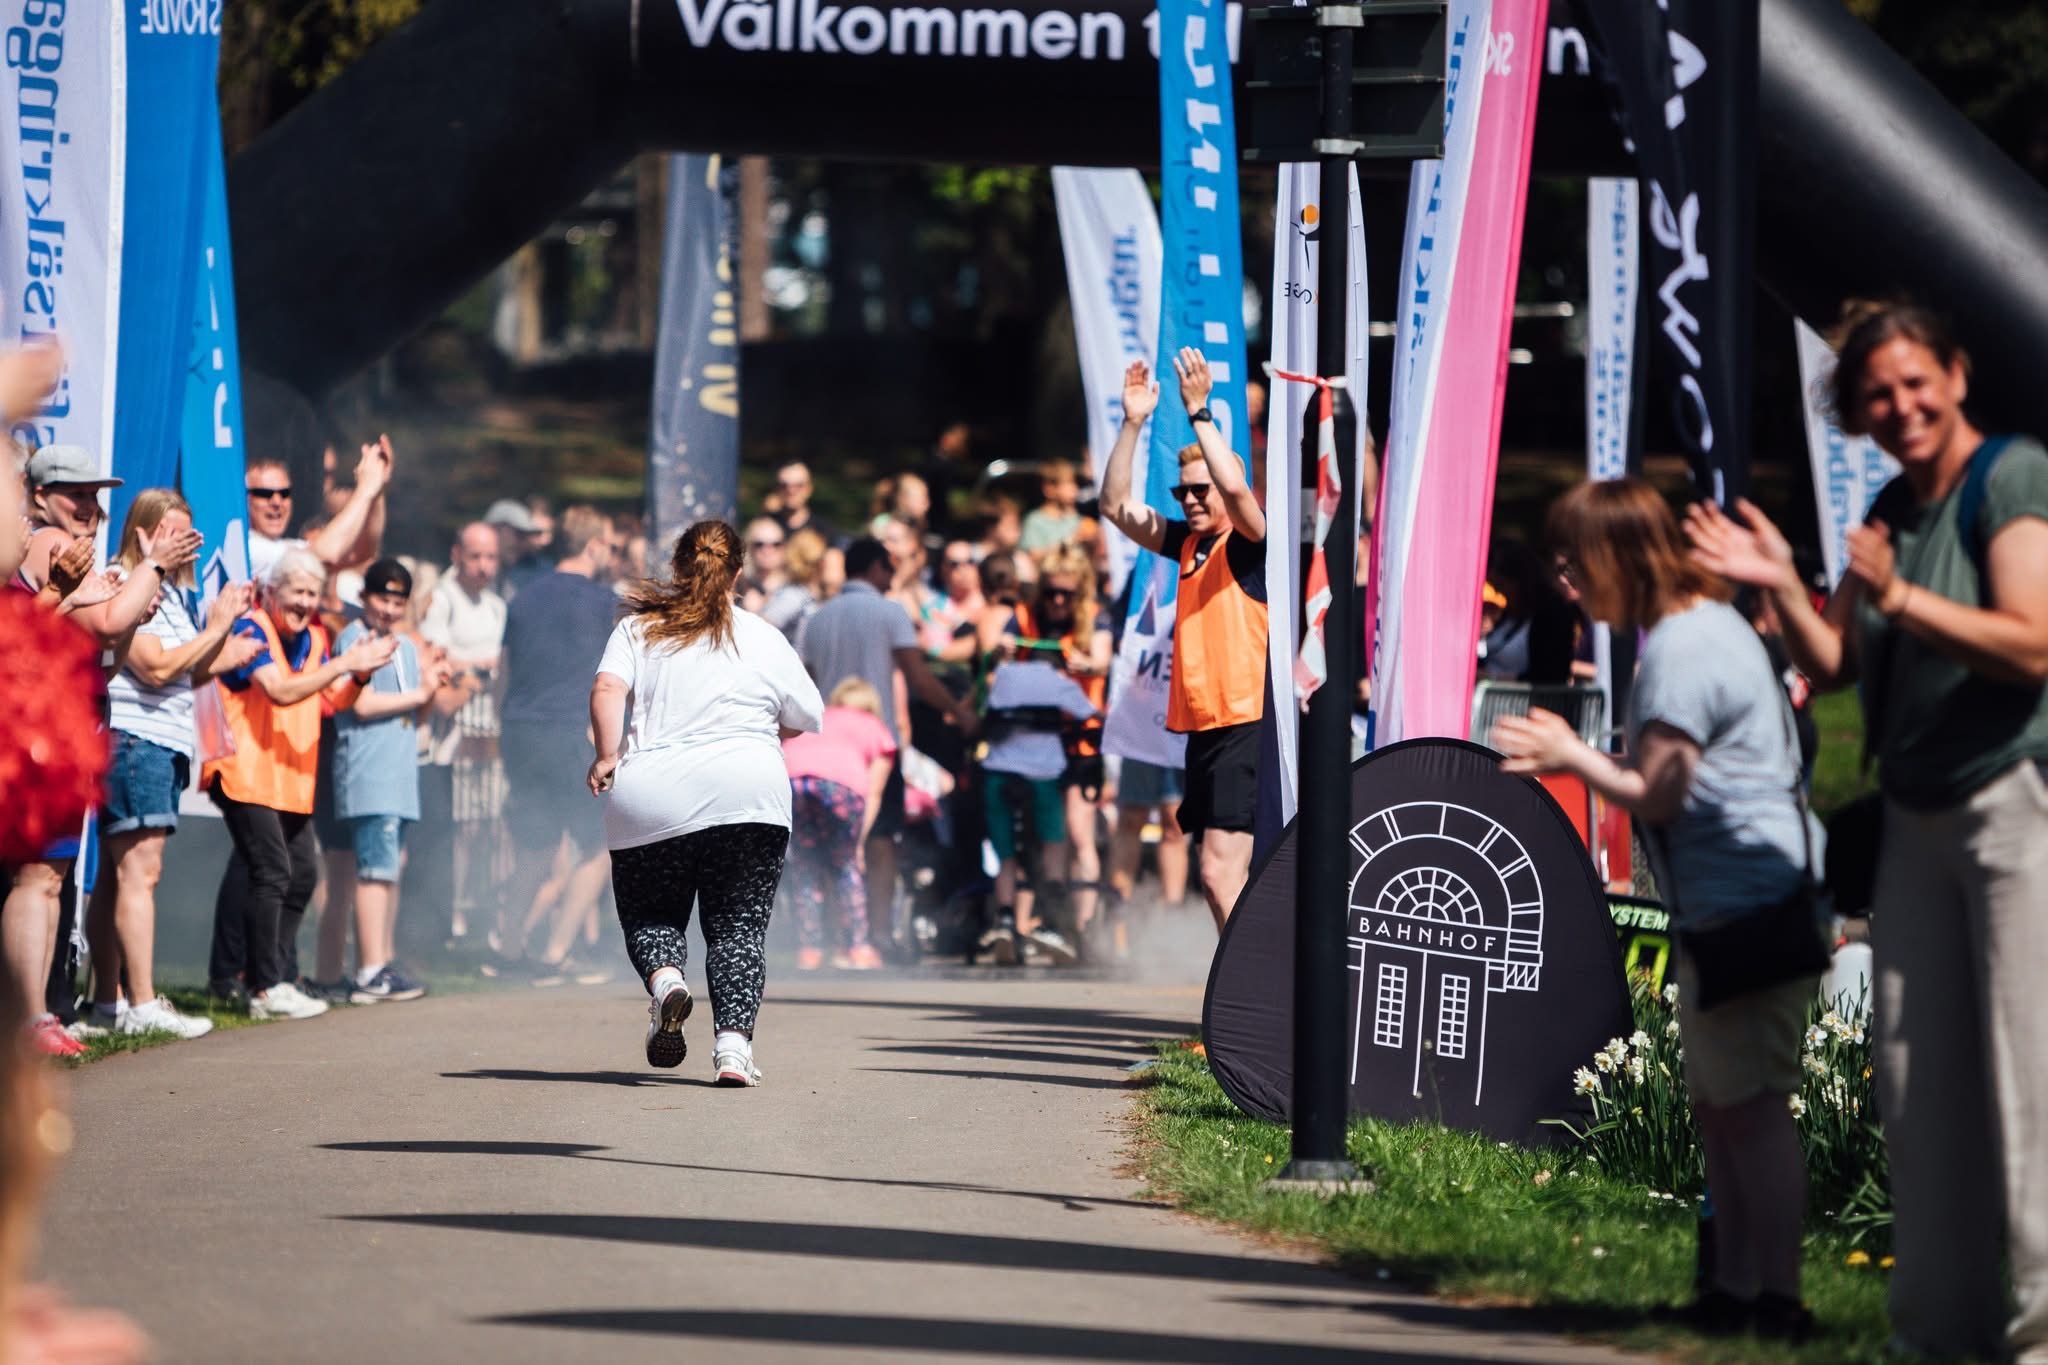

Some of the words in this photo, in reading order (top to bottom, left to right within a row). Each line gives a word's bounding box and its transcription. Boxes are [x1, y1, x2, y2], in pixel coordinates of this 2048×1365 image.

[674, 0, 1126, 60] Välkommen
[1607, 902, 1671, 931] YSTEM
[1359, 917, 1497, 952] BAHNHOF
